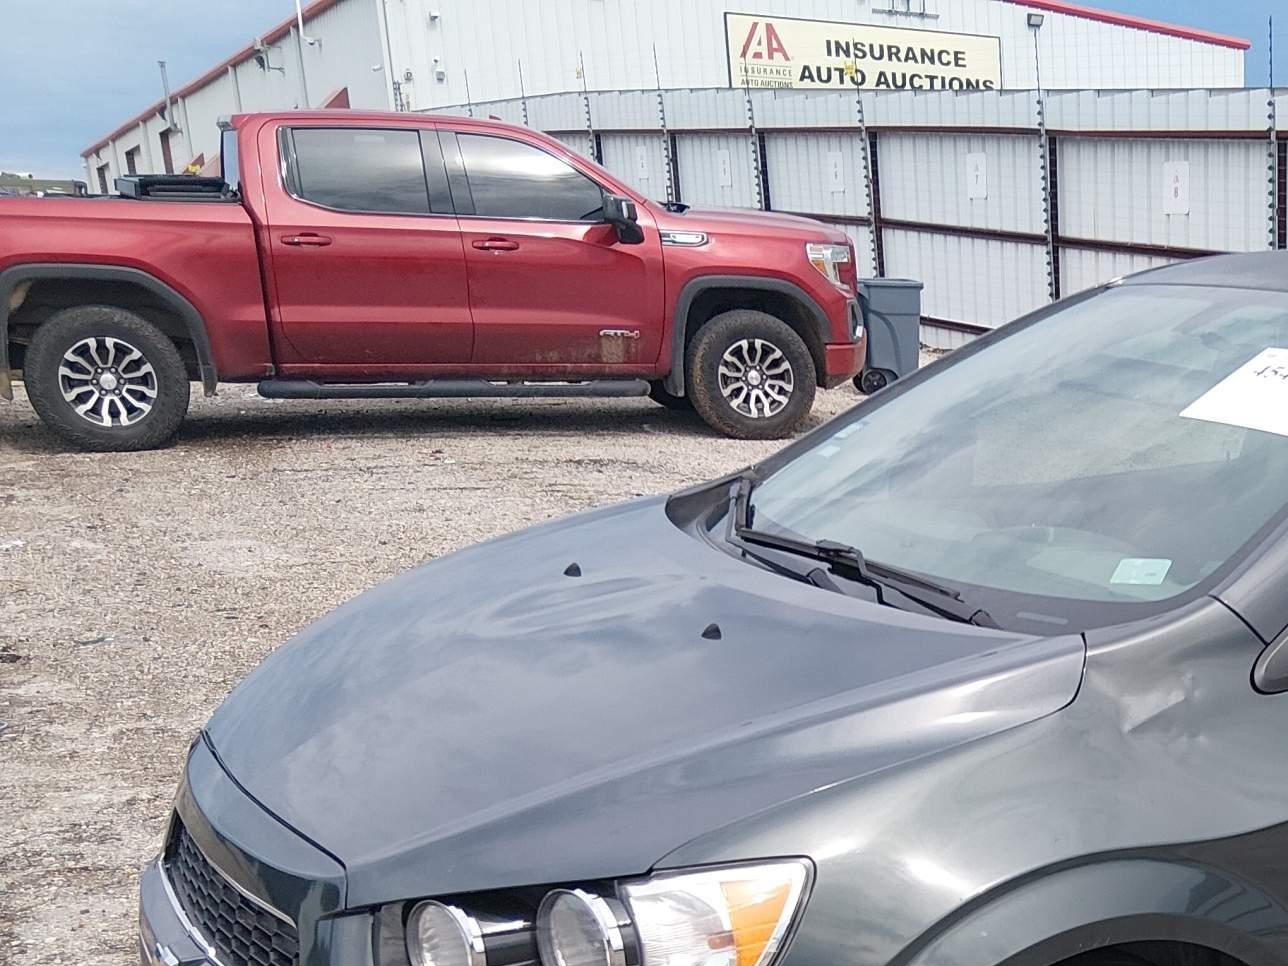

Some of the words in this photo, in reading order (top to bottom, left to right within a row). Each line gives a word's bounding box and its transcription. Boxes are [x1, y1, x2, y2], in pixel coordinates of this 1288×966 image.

[825, 39, 967, 67] INSURANCE
[799, 64, 867, 87] AUTO
[875, 70, 995, 90] AUCTIONS
